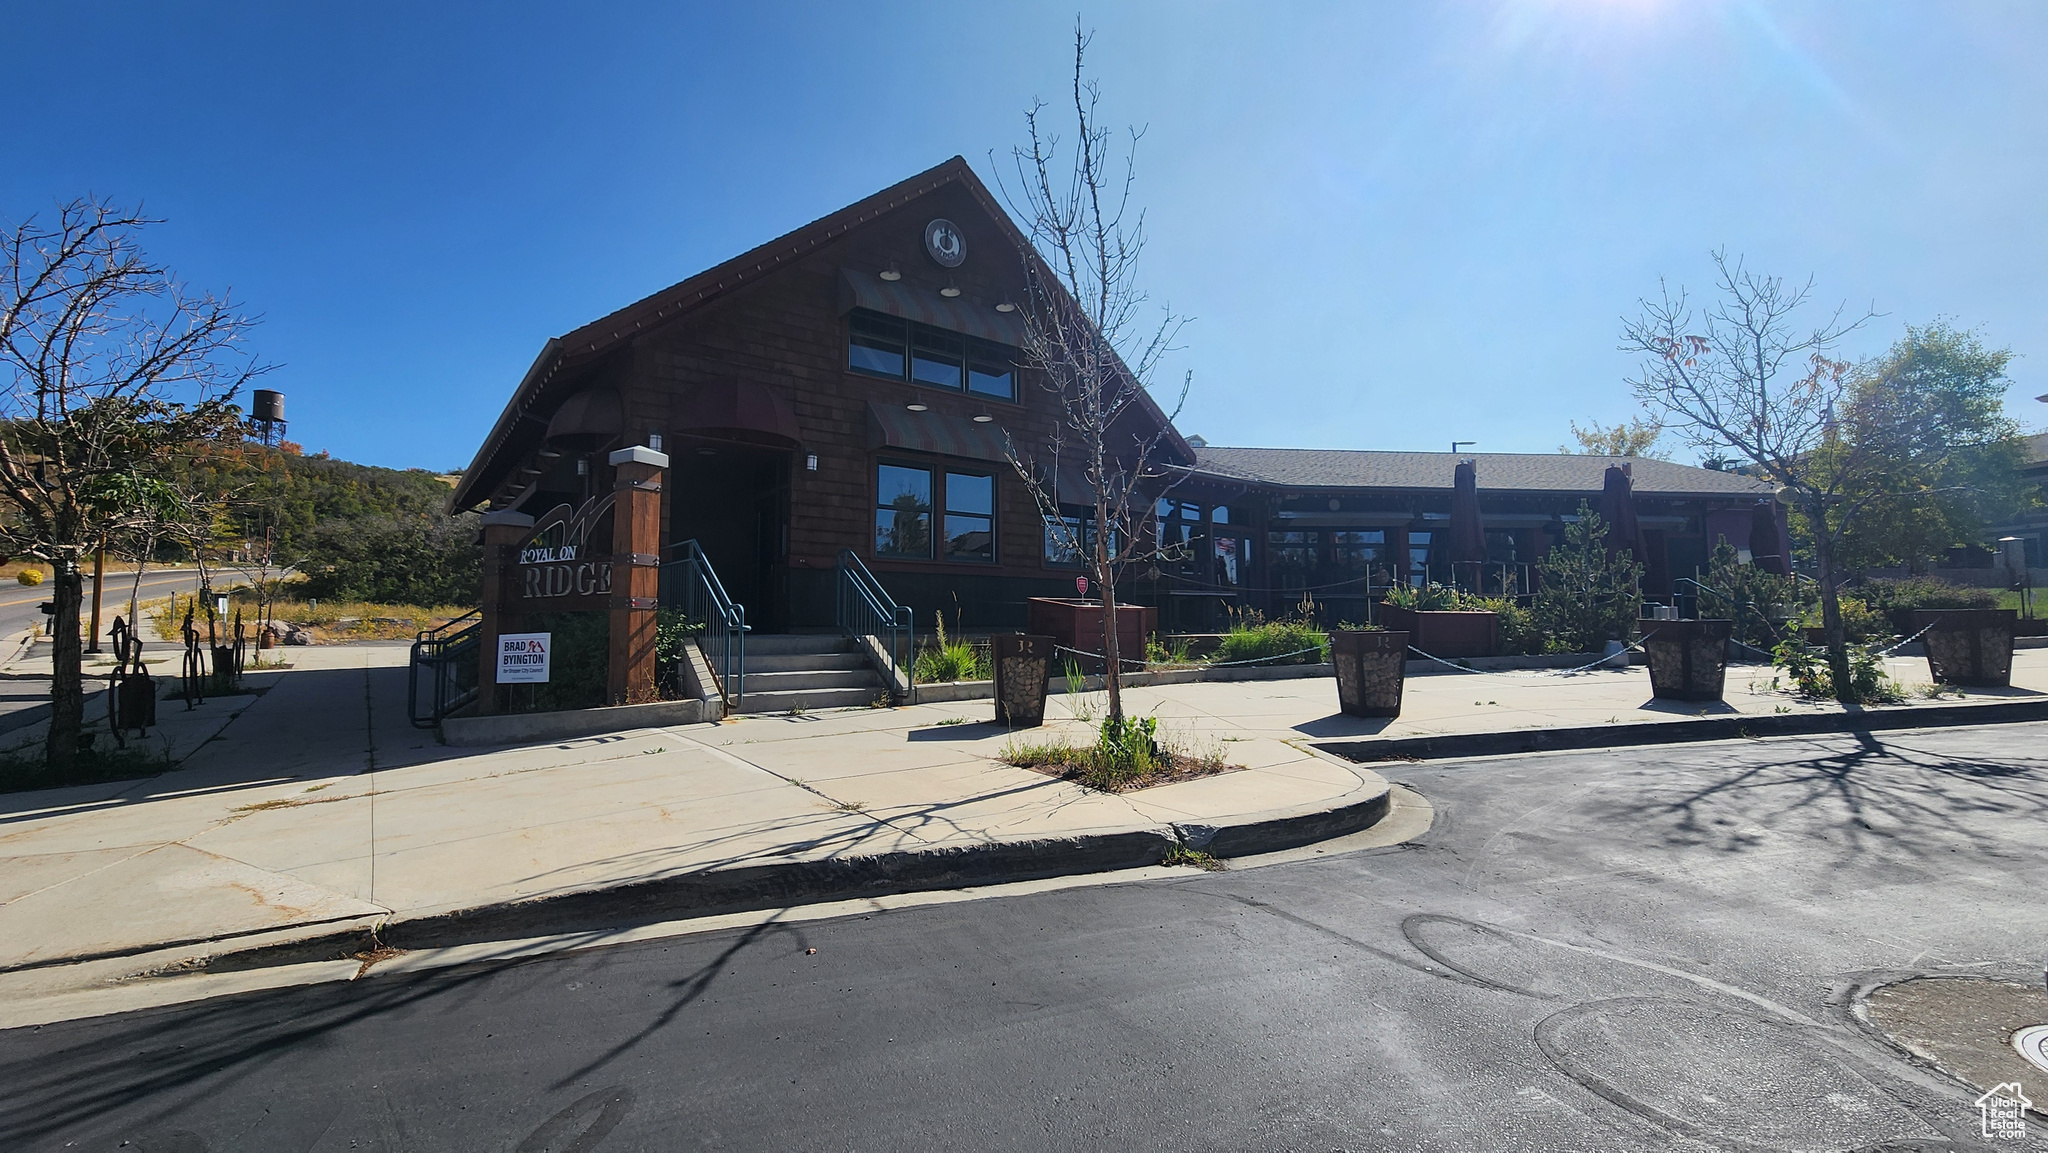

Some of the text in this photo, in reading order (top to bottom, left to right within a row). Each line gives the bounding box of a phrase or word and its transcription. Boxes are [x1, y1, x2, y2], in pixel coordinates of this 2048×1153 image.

[520, 545, 578, 564] ROYAL ON
[523, 562, 614, 598] RIDGE
[504, 641, 526, 652] BRAD
[503, 654, 544, 665] BYINGTON
